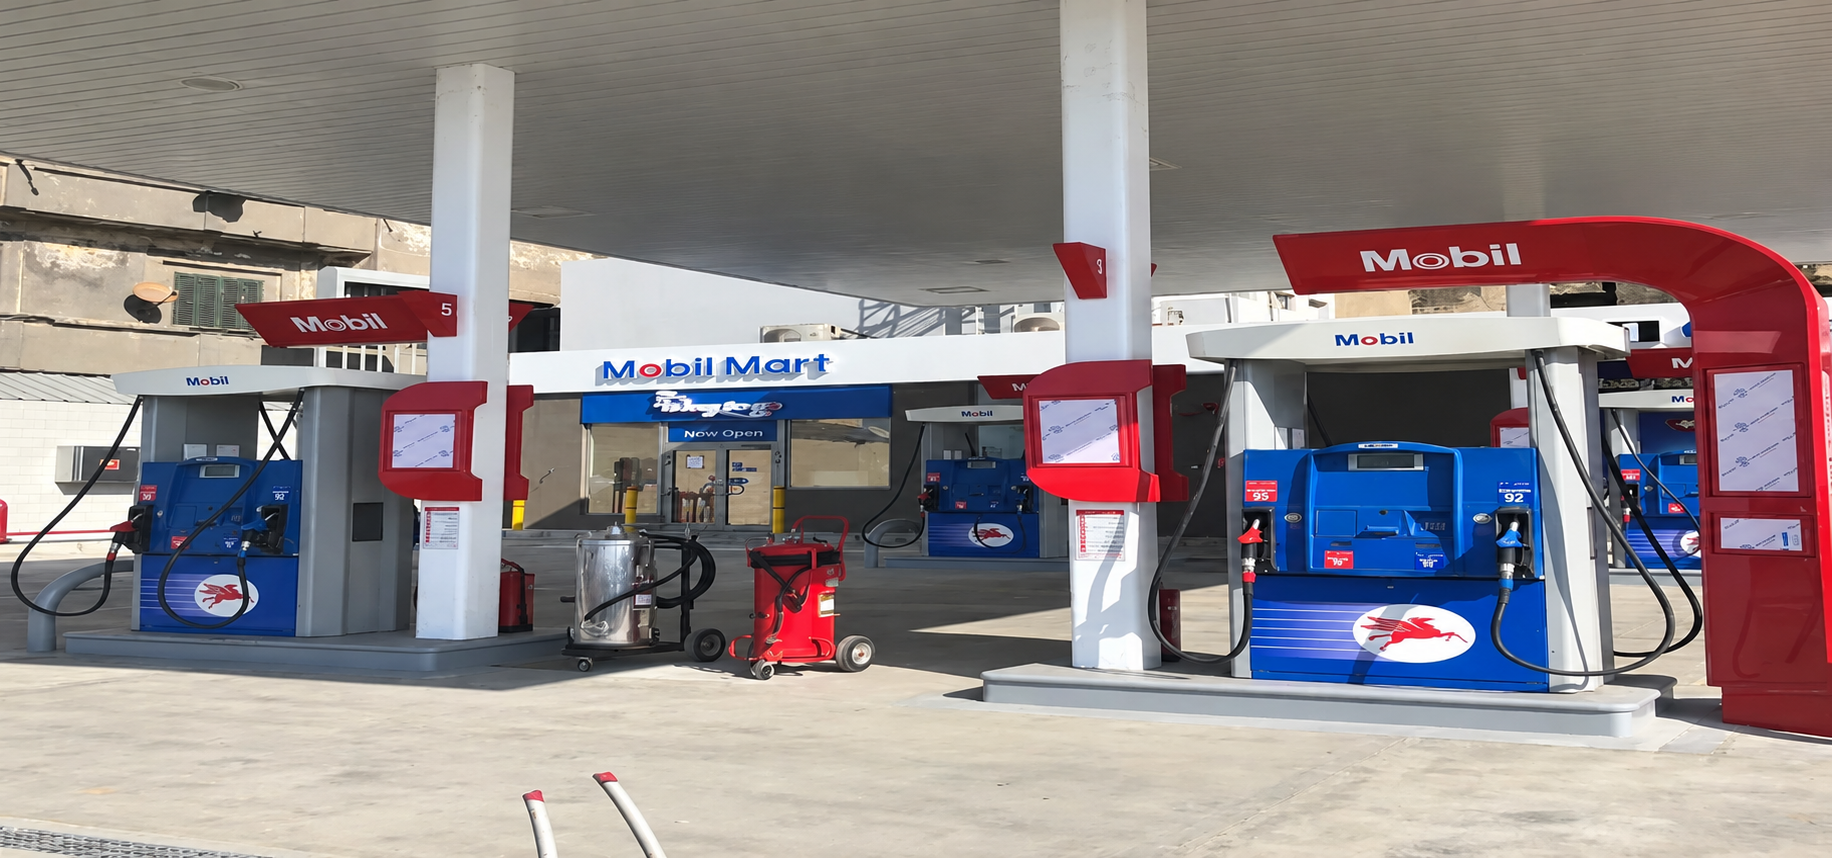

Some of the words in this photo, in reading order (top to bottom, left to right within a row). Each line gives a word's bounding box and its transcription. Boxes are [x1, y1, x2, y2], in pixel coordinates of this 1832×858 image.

[1360, 242, 1522, 273] Mobil
[440, 302, 453, 317] 5
[289, 312, 389, 334] Mobil
[1334, 331, 1415, 347] Mobil
[603, 356, 713, 379] Mobil
[726, 353, 830, 375] Mart
[186, 375, 230, 387] Mobil
[1671, 395, 1695, 404] Mo
[961, 410, 993, 418] Mobil
[684, 429, 718, 438] Now
[722, 429, 763, 439] Open
[1504, 492, 1524, 503] 92
